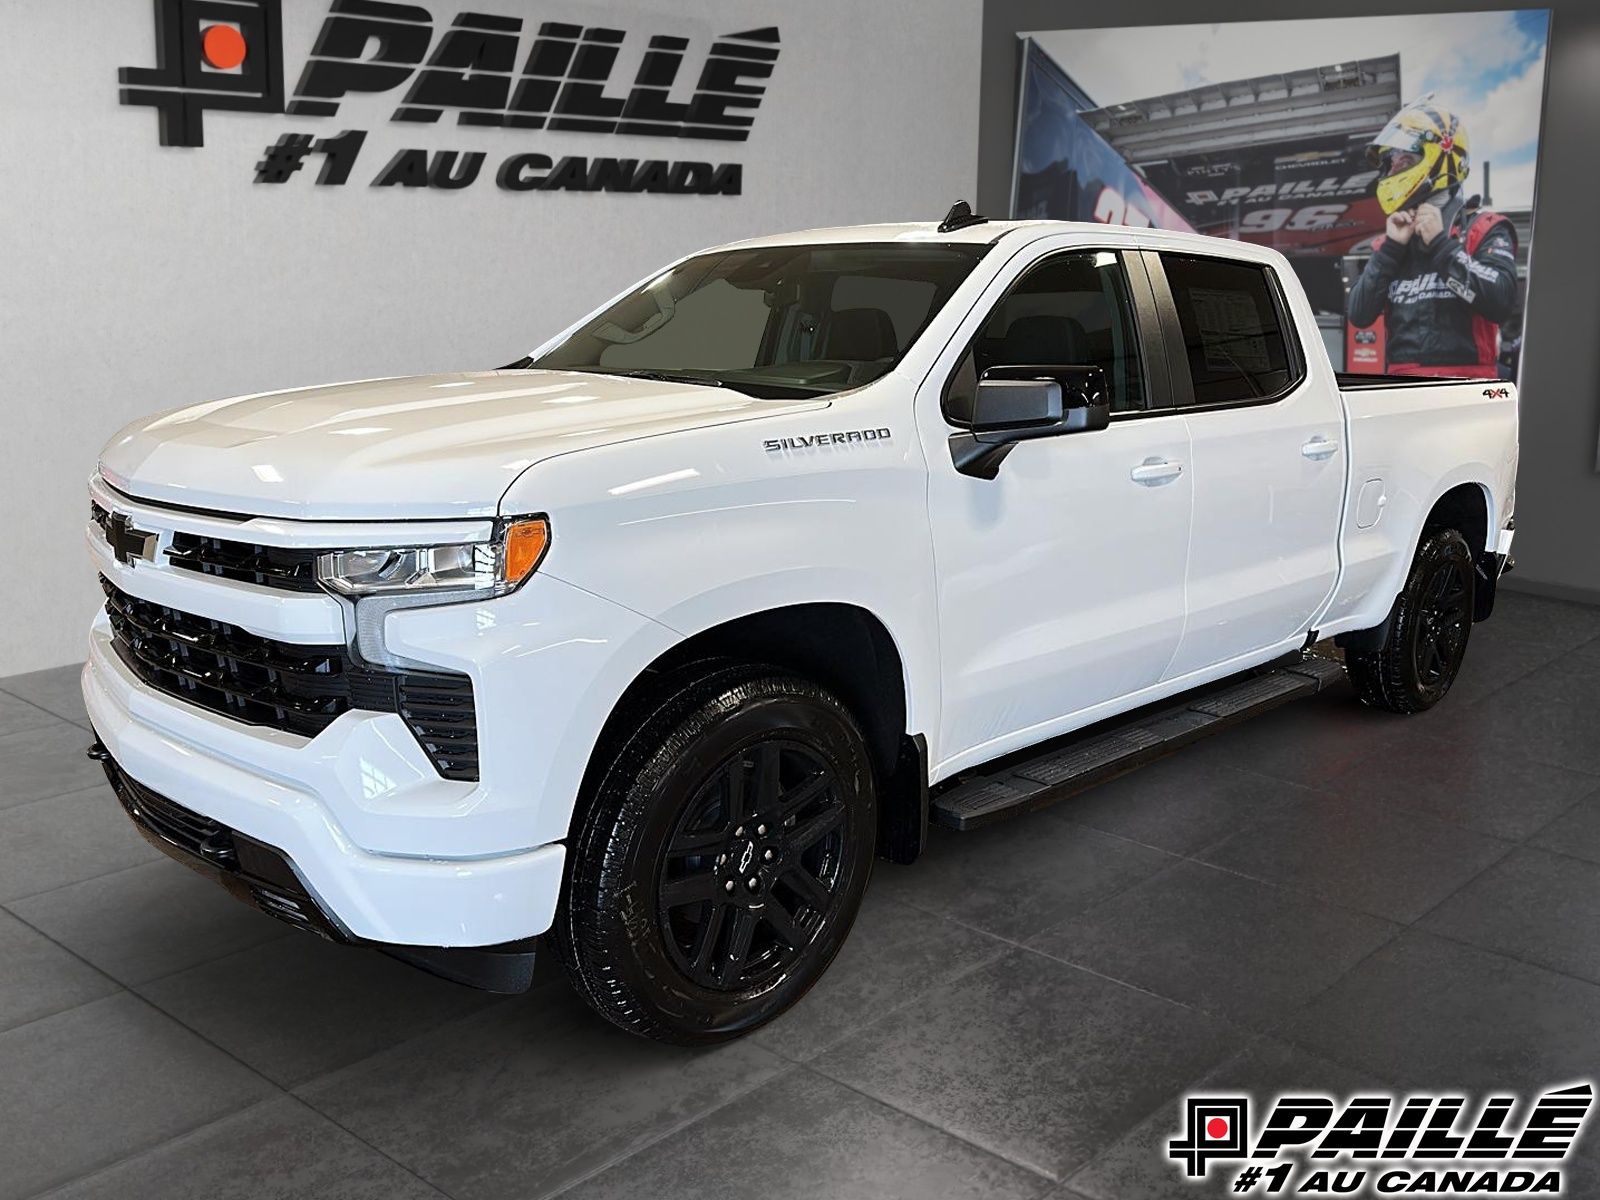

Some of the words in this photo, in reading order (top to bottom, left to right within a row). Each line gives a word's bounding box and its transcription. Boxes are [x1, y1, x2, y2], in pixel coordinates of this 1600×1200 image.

[285, 0, 780, 141] PAILLÉ
[254, 130, 368, 186] #1
[370, 148, 487, 189] AU
[496, 154, 742, 195] CANADA
[1278, 188, 1367, 200] CANADA
[1240, 204, 1348, 233] 96
[763, 427, 892, 452] SILVERADO
